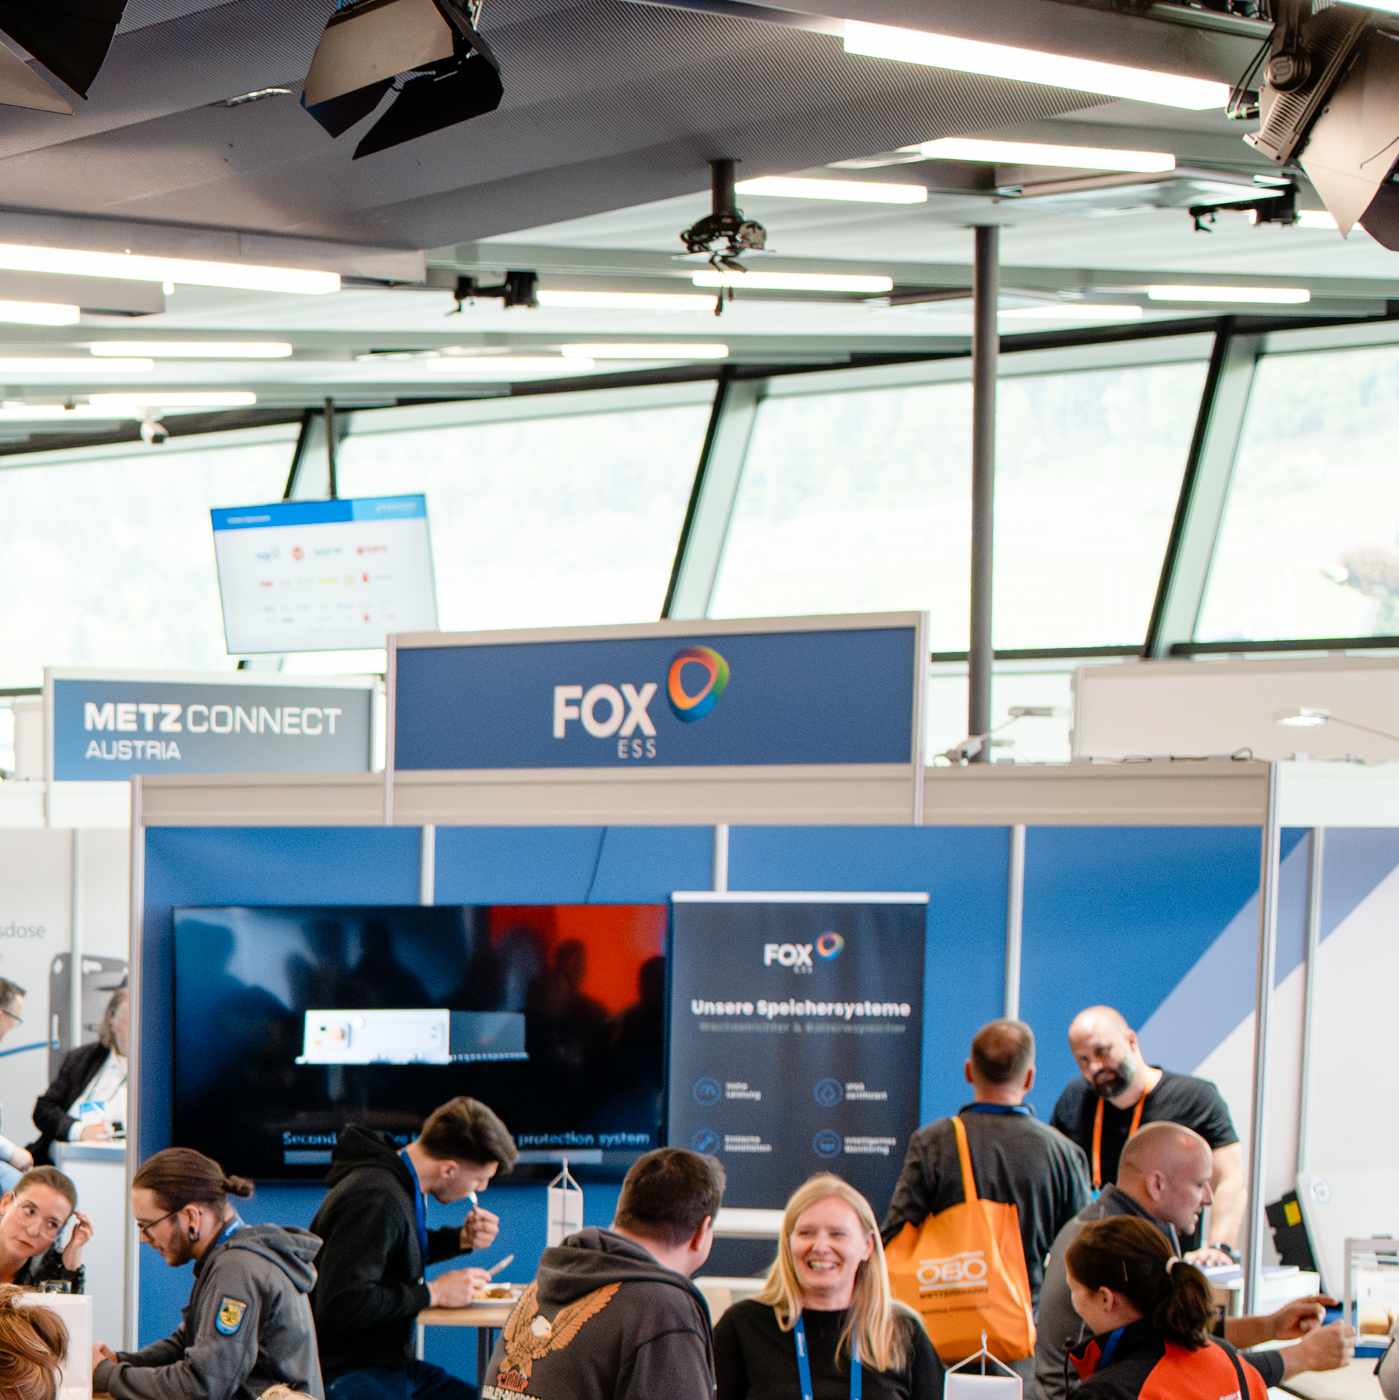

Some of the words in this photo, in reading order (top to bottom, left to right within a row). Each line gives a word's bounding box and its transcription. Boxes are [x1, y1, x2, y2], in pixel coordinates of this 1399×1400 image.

[84, 702, 183, 732] METZ
[186, 704, 343, 735] CONNECT
[554, 682, 658, 739] FOX
[84, 740, 182, 760] AUSTRIA
[617, 738, 657, 759] ESS
[763, 943, 813, 966] FOX
[691, 999, 755, 1016] Unsere
[756, 998, 912, 1020] Speichersysteme
[916, 1257, 988, 1285] OBO
